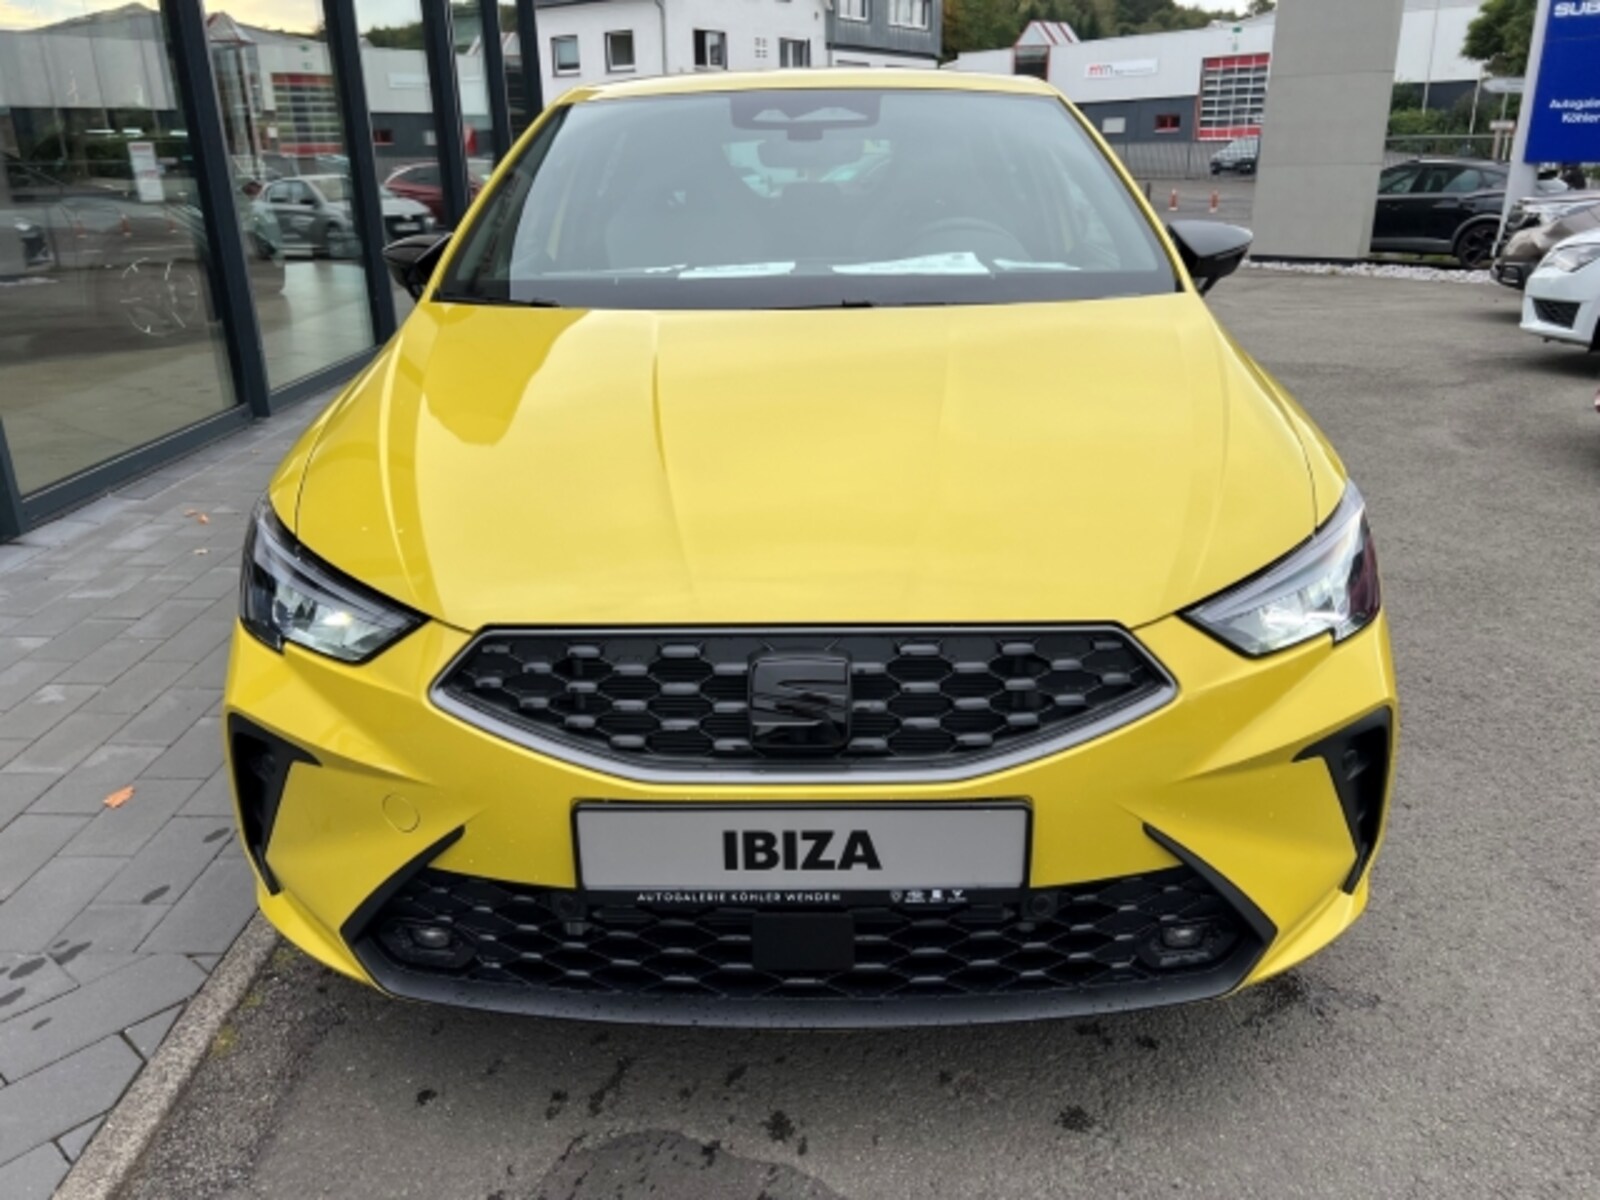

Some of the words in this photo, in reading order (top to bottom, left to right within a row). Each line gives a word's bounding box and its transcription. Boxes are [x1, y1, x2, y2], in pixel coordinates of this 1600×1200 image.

[722, 829, 883, 871] IBIZA
[636, 891, 726, 903] AUTOGALERIE
[785, 891, 841, 903] WENDEN
